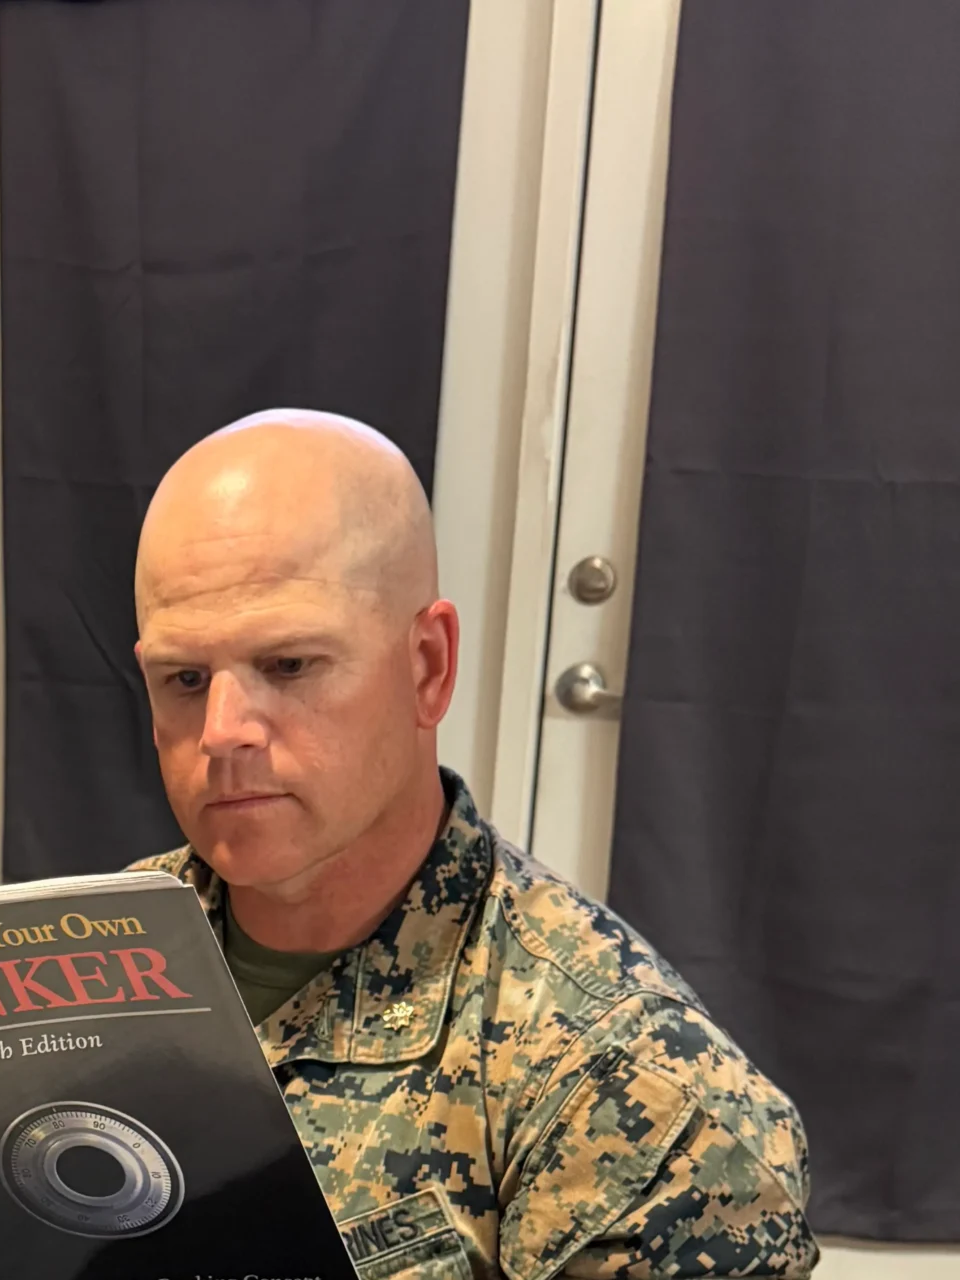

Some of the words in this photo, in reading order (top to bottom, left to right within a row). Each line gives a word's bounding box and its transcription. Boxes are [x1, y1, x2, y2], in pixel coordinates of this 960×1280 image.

[59, 912, 147, 939] Own
[19, 1032, 103, 1057] Edition
[52, 1120, 66, 1129] 80
[93, 1121, 106, 1131] 90
